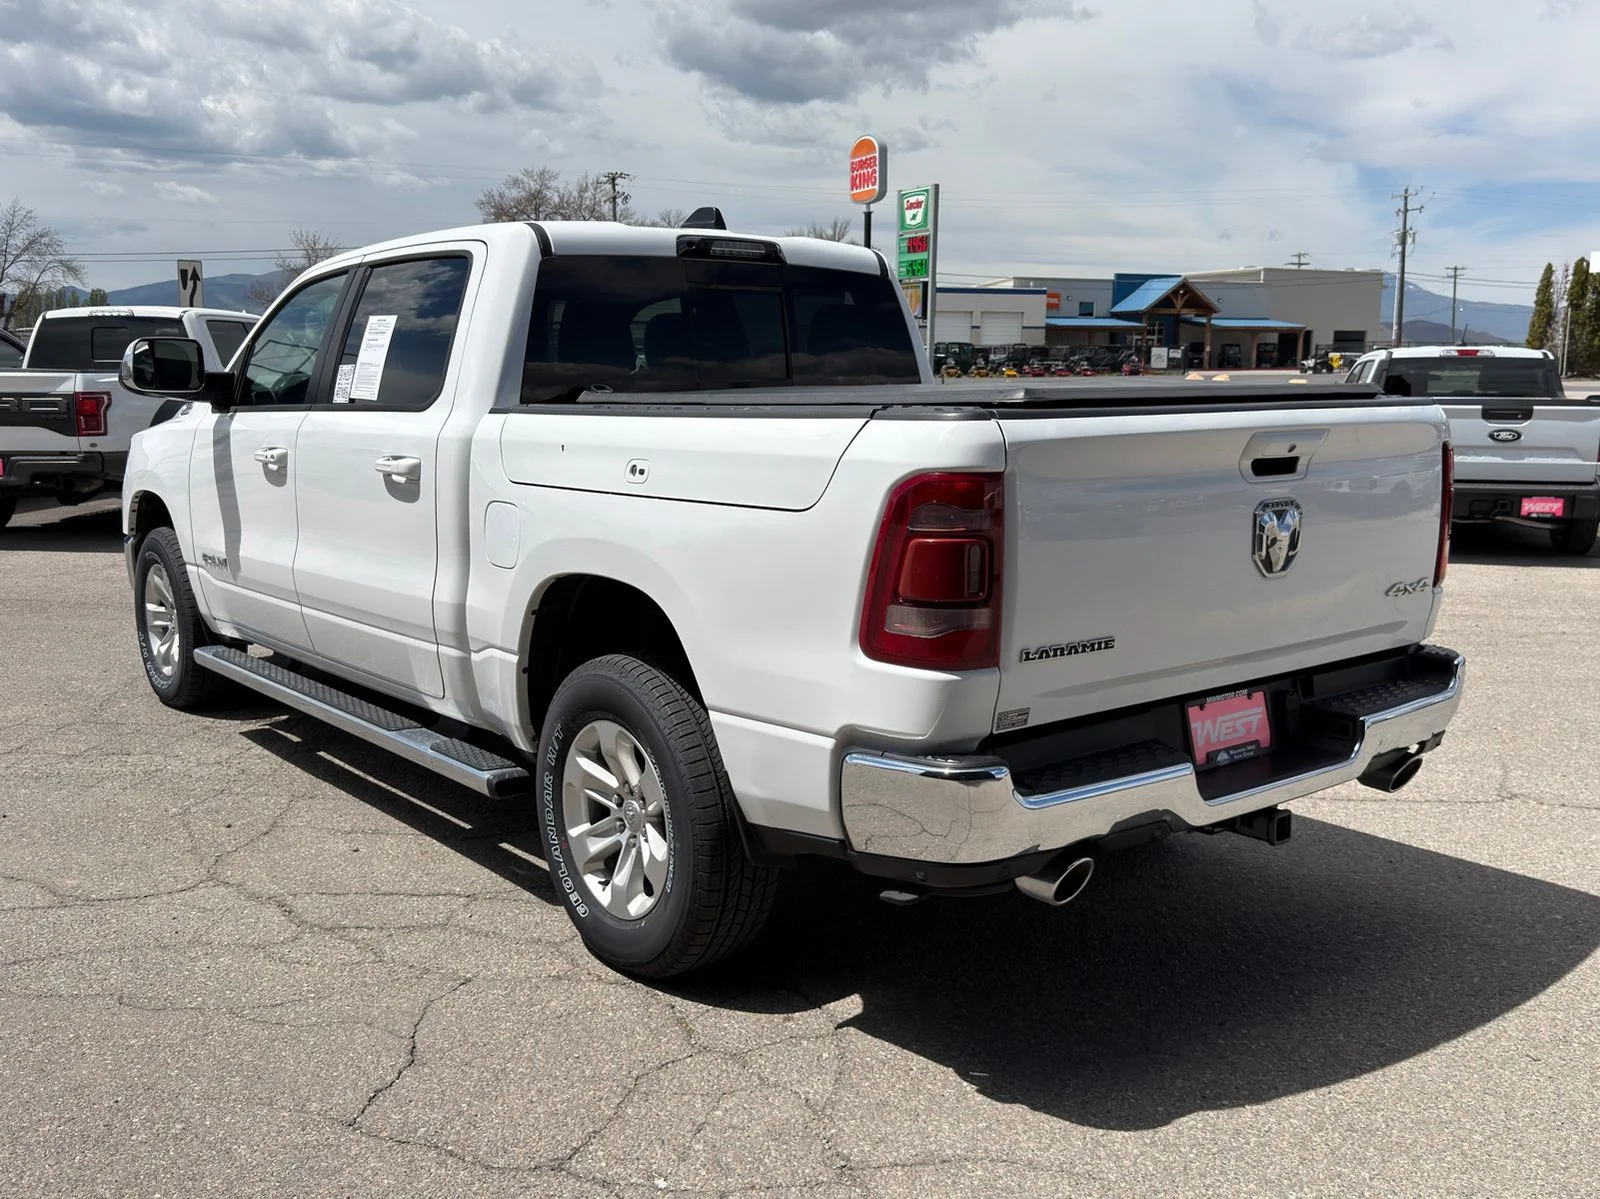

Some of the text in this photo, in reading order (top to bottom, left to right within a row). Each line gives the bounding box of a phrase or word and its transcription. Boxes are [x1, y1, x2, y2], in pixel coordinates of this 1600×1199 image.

[851, 155, 877, 174] BURGER
[851, 168, 877, 192] KING
[1021, 637, 1116, 662] LARAMIE
[1191, 706, 1264, 747] WEST
[543, 771, 589, 918] GEOLANDAR
